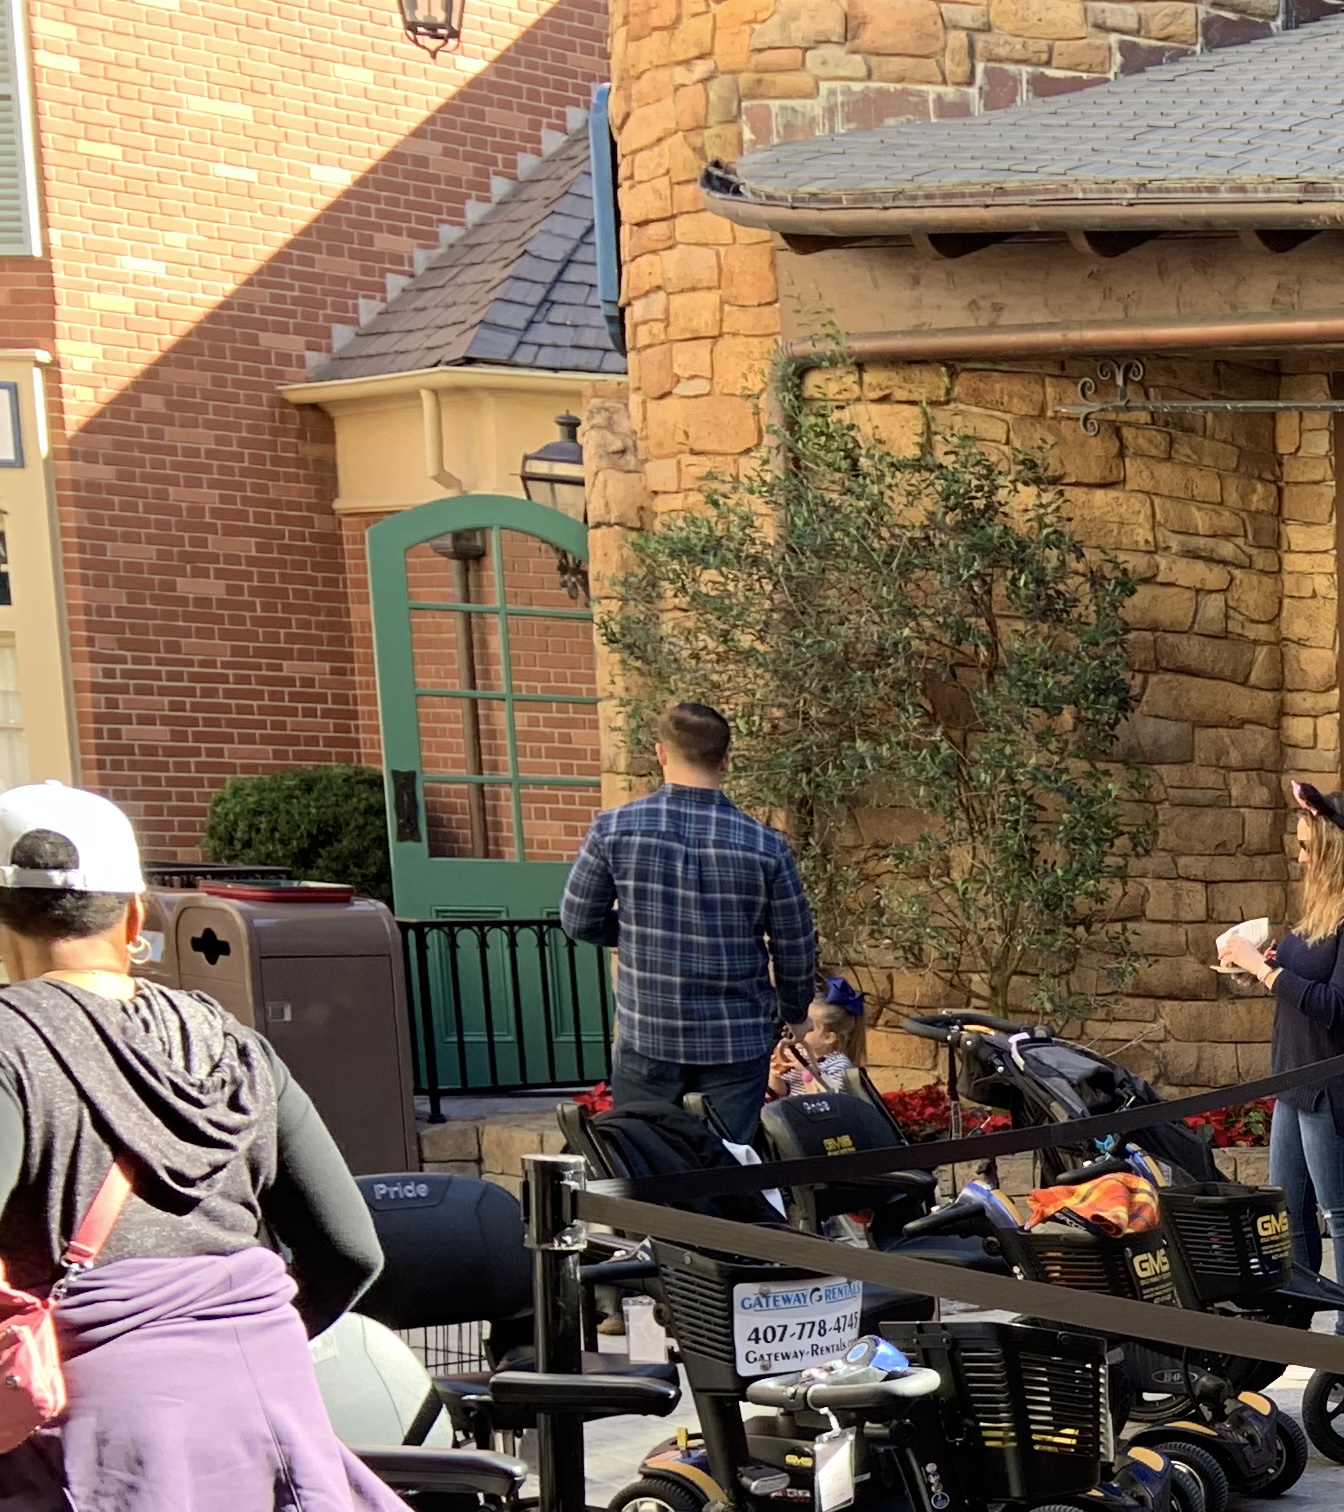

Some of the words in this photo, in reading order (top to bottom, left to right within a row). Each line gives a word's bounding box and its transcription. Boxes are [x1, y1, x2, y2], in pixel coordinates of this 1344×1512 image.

[373, 1181, 429, 1200] Pride
[1256, 1211, 1289, 1237] GMS
[1132, 1248, 1170, 1278] GMS
[740, 1292, 809, 1310] GATEWAY
[825, 1282, 861, 1300] RENTALS
